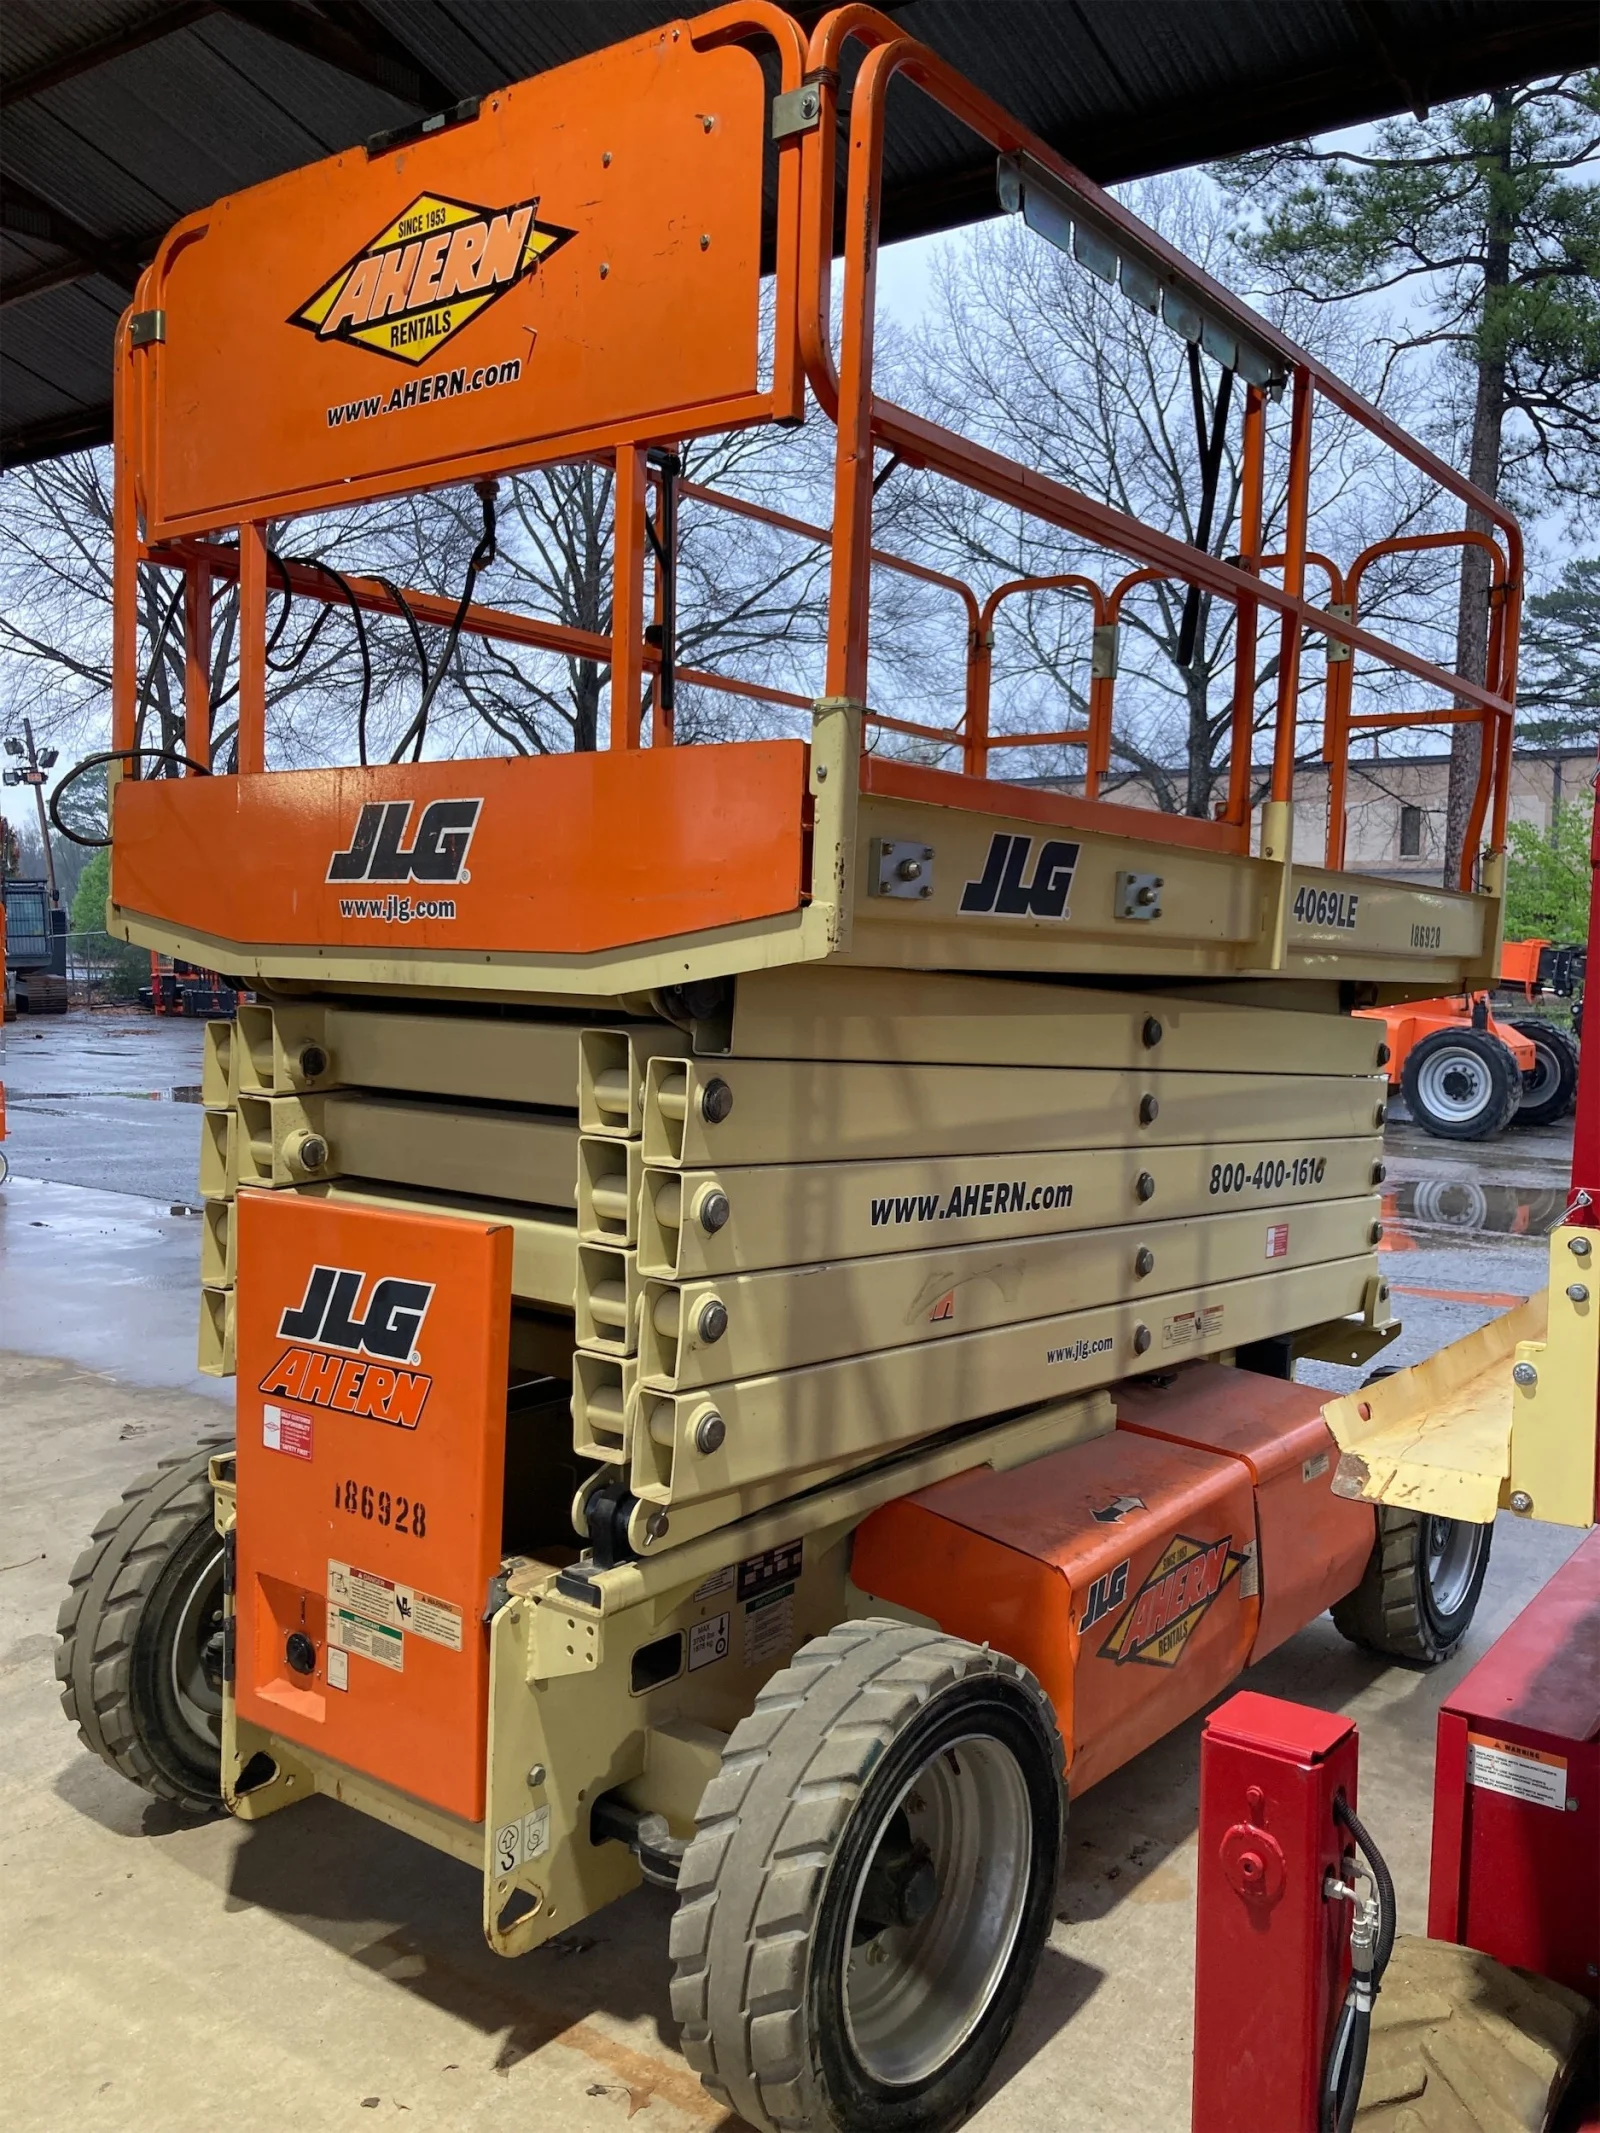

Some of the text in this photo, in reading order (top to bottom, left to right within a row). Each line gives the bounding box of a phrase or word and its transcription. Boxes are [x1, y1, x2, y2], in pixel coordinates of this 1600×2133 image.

[398, 208, 446, 238] SINCE 1953
[319, 206, 534, 335] AHERN
[390, 310, 452, 348] RENTALS
[327, 358, 521, 427] www.AHERN.com
[327, 800, 482, 880] JLG
[959, 834, 1081, 917] JLG
[340, 896, 455, 920] www.jlg.com
[1294, 887, 1358, 928] 4069LE
[1410, 923, 1441, 949] 186928
[871, 1181, 1074, 1226] www.AHERN.com
[280, 1267, 433, 1360] JLG
[1047, 1338, 1113, 1363] www.jlg.com
[259, 1349, 432, 1428] AHERN
[334, 1480, 426, 1538] 186928
[363, 1574, 386, 1587] DANGER
[1079, 1561, 1129, 1633] JLG
[1120, 1541, 1229, 1658] AHERN
[698, 1624, 711, 1634] MAX
[1158, 1620, 1188, 1657] RENTALS
[1504, 1744, 1540, 1759] WARNING
